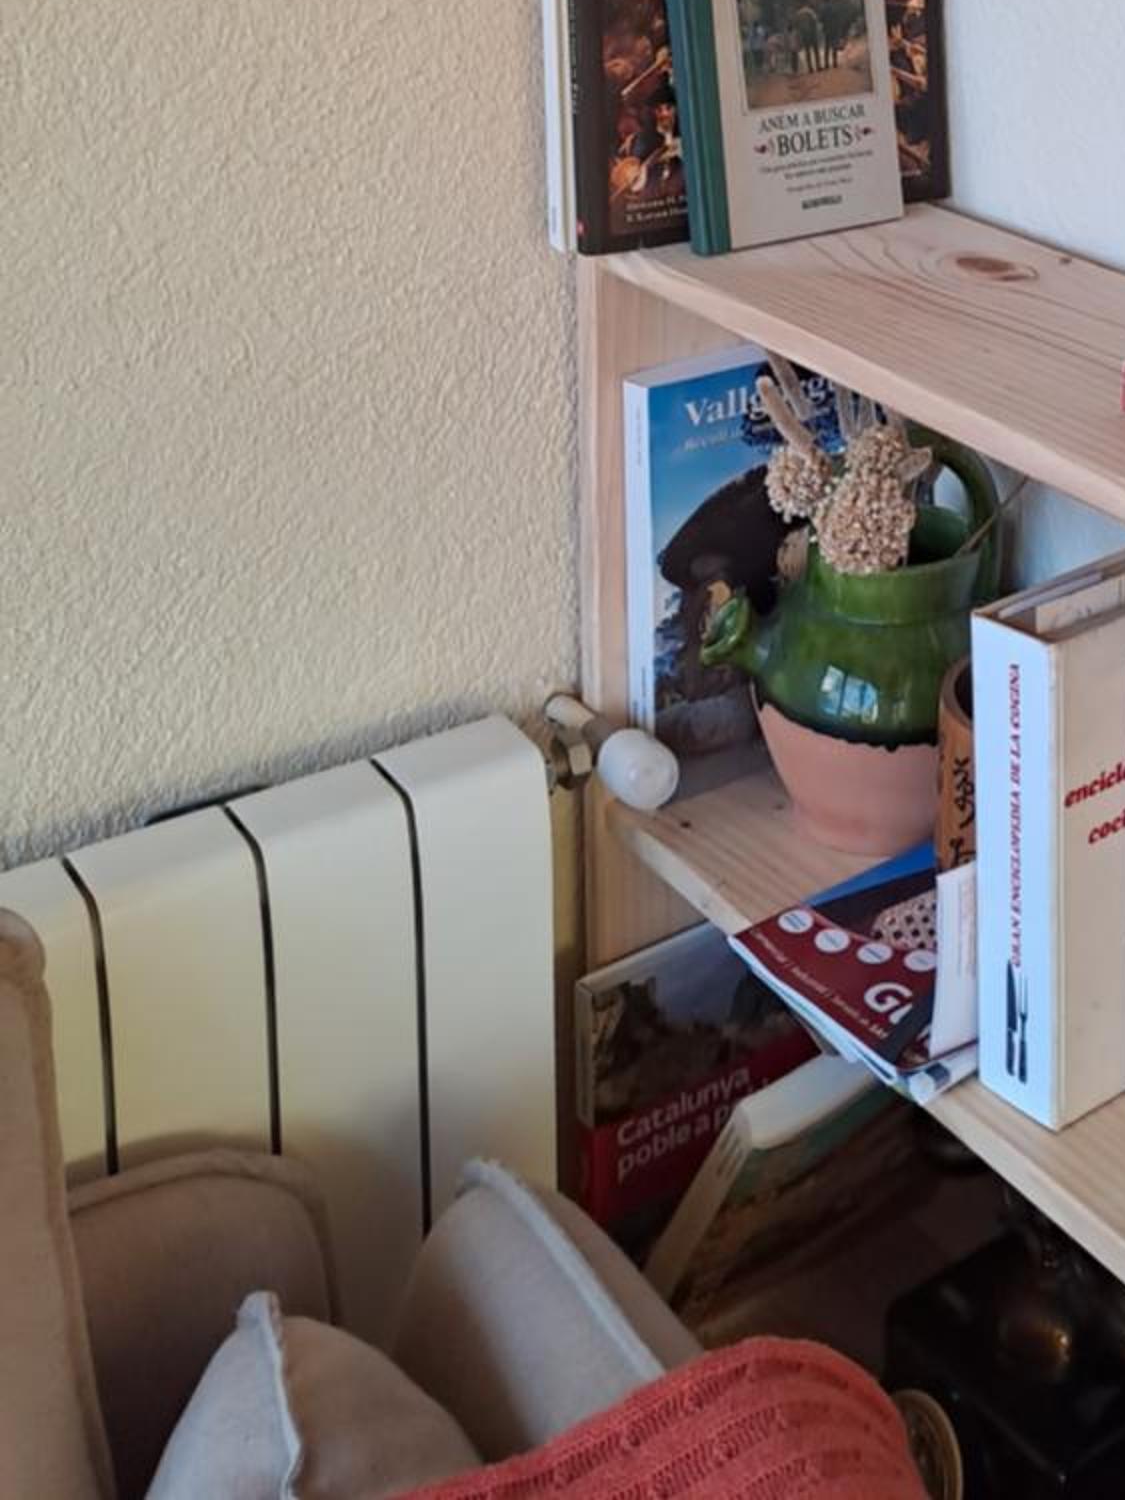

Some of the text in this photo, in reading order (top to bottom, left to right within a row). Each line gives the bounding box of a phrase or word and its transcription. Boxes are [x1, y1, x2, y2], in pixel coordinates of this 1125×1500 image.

[776, 122, 854, 158] BOLETS
[1008, 662, 1022, 967] GRAN ENCICLOPEDIA DE LA COCINA
[616, 1065, 751, 1148] Catalunya
[617, 1123, 692, 1181] poble
